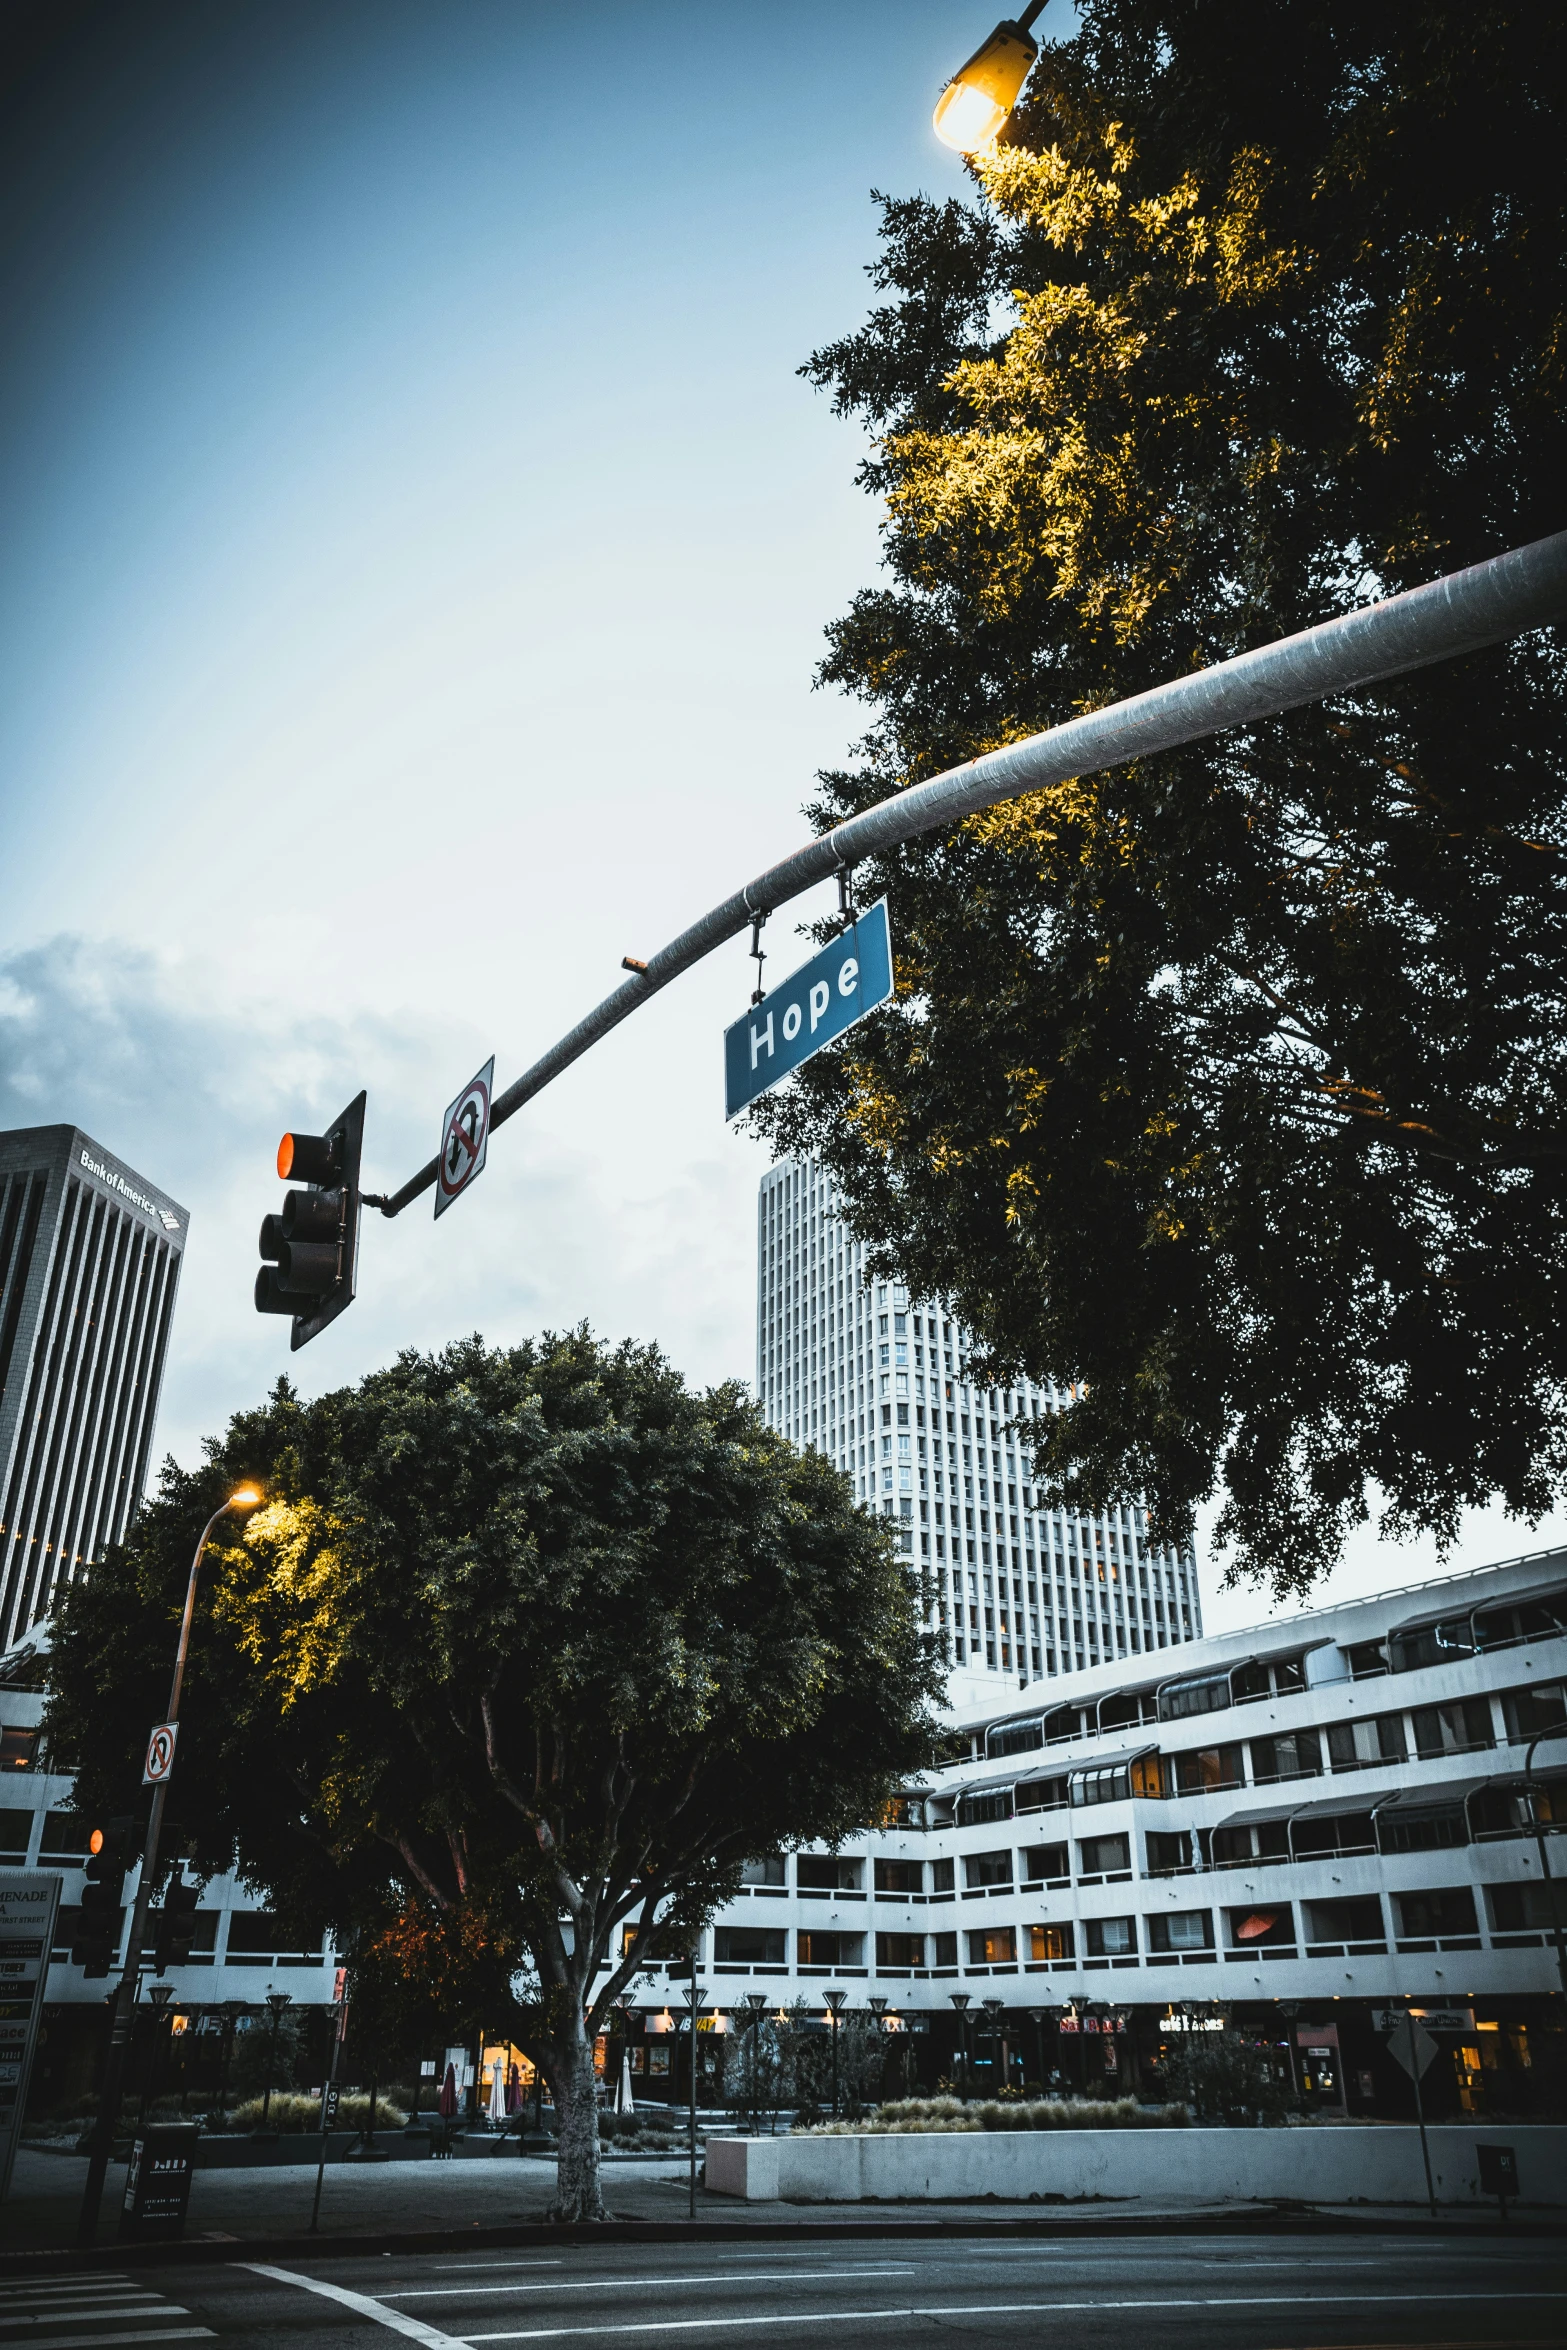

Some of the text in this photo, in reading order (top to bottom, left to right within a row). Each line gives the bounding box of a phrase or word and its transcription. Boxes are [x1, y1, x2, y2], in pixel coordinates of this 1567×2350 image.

[750, 957, 859, 1071] Hope
[80, 1149, 156, 1216] Bank of America
[19, 1915, 46, 1923] STREET
[664, 2017, 718, 2032] SBWAY
[1060, 2018, 1081, 2032] Nai
